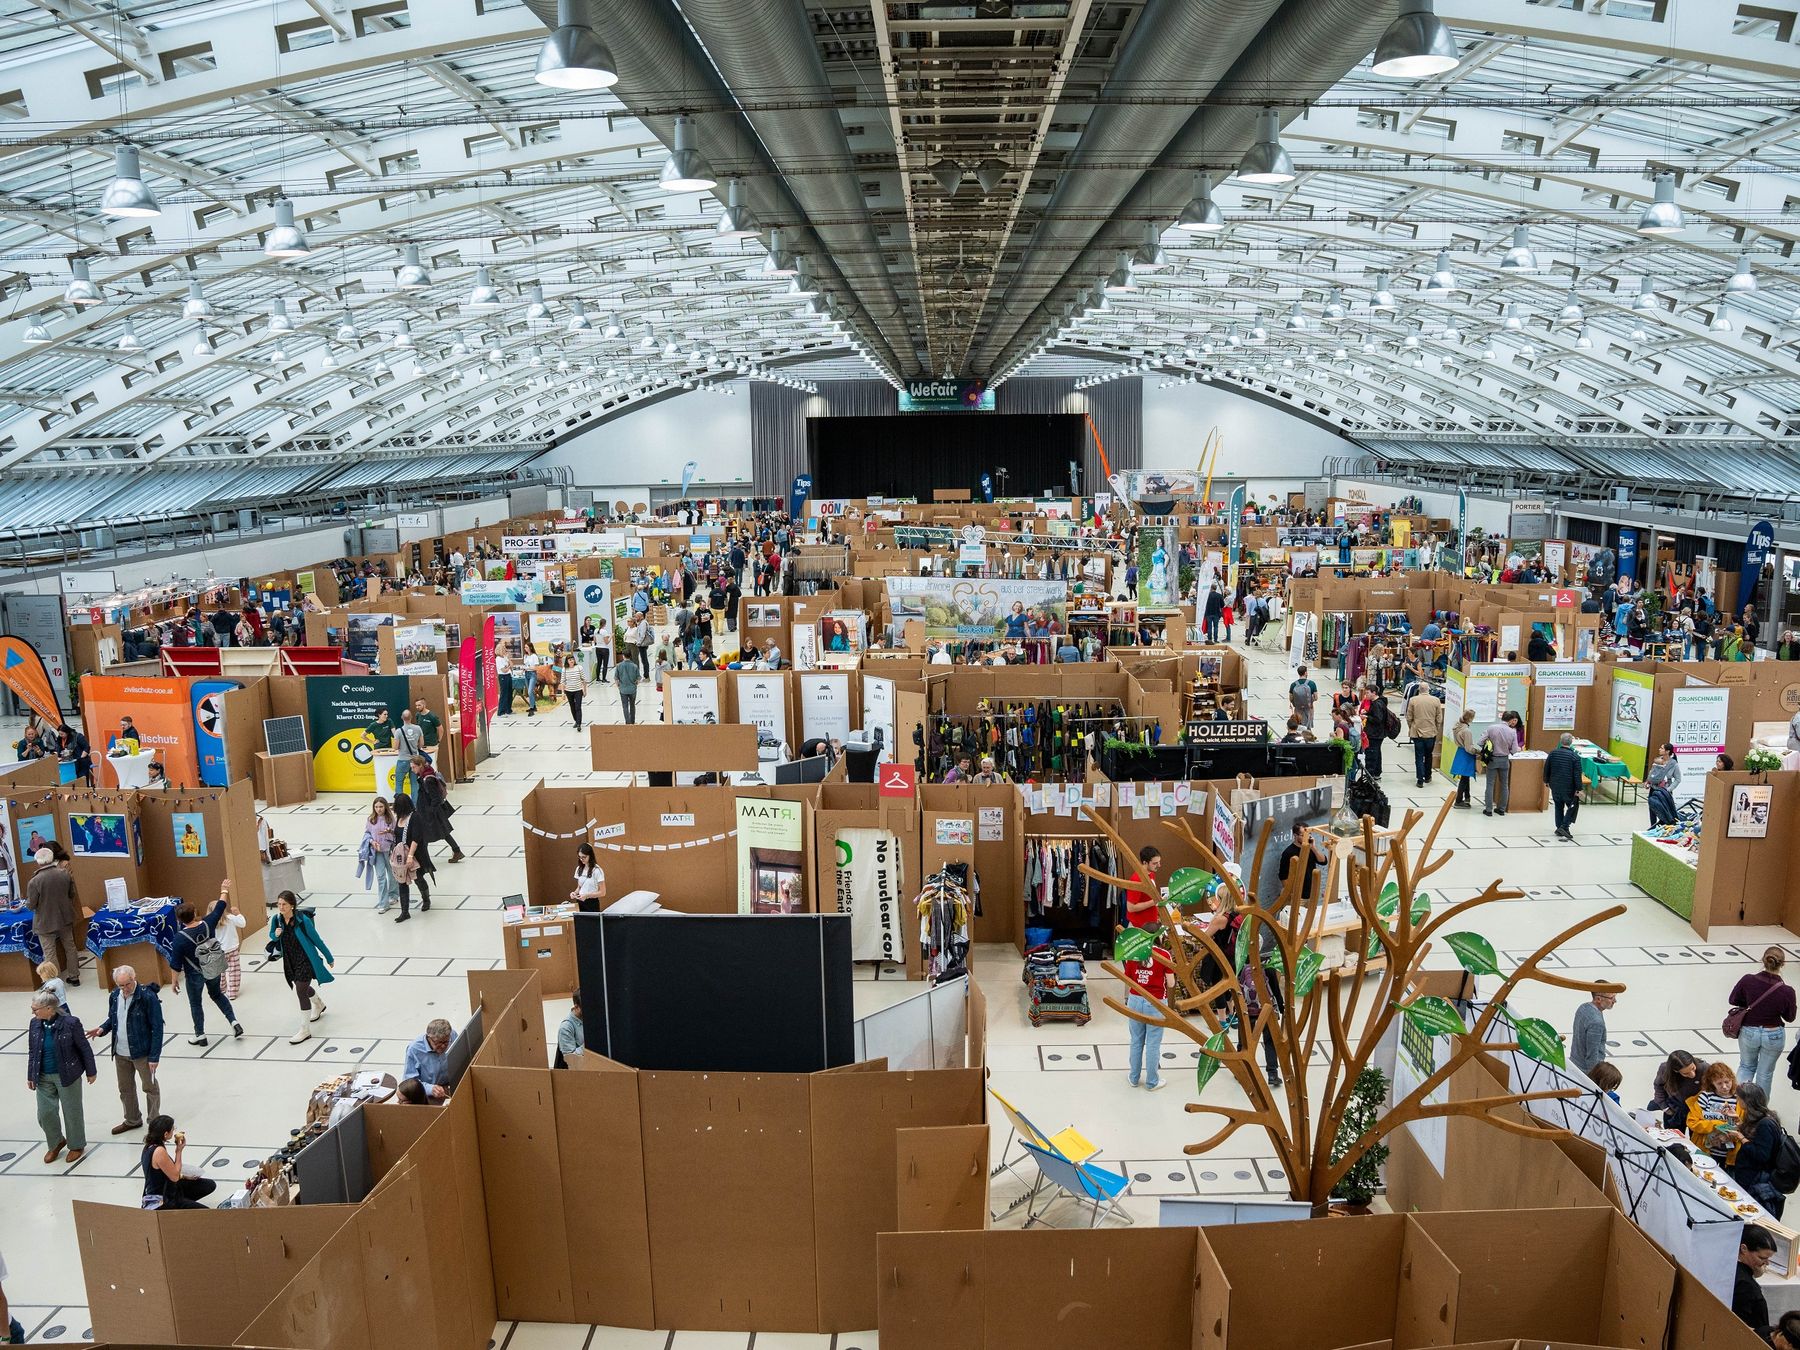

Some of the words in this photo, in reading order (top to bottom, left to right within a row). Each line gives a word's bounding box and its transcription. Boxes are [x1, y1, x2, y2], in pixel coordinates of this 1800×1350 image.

[910, 381, 958, 397] WeFair
[796, 478, 811, 488] Tips
[821, 501, 841, 514] OÖN
[1619, 536, 1634, 546] Tips
[1752, 530, 1771, 549] Tips
[544, 616, 562, 624] indigo
[351, 685, 374, 693] ecoligo
[461, 668, 472, 712] WAGRAIN
[876, 839, 888, 864] No
[836, 870, 844, 885] the
[844, 870, 853, 905] Friends
[877, 869, 893, 931] nuclear
